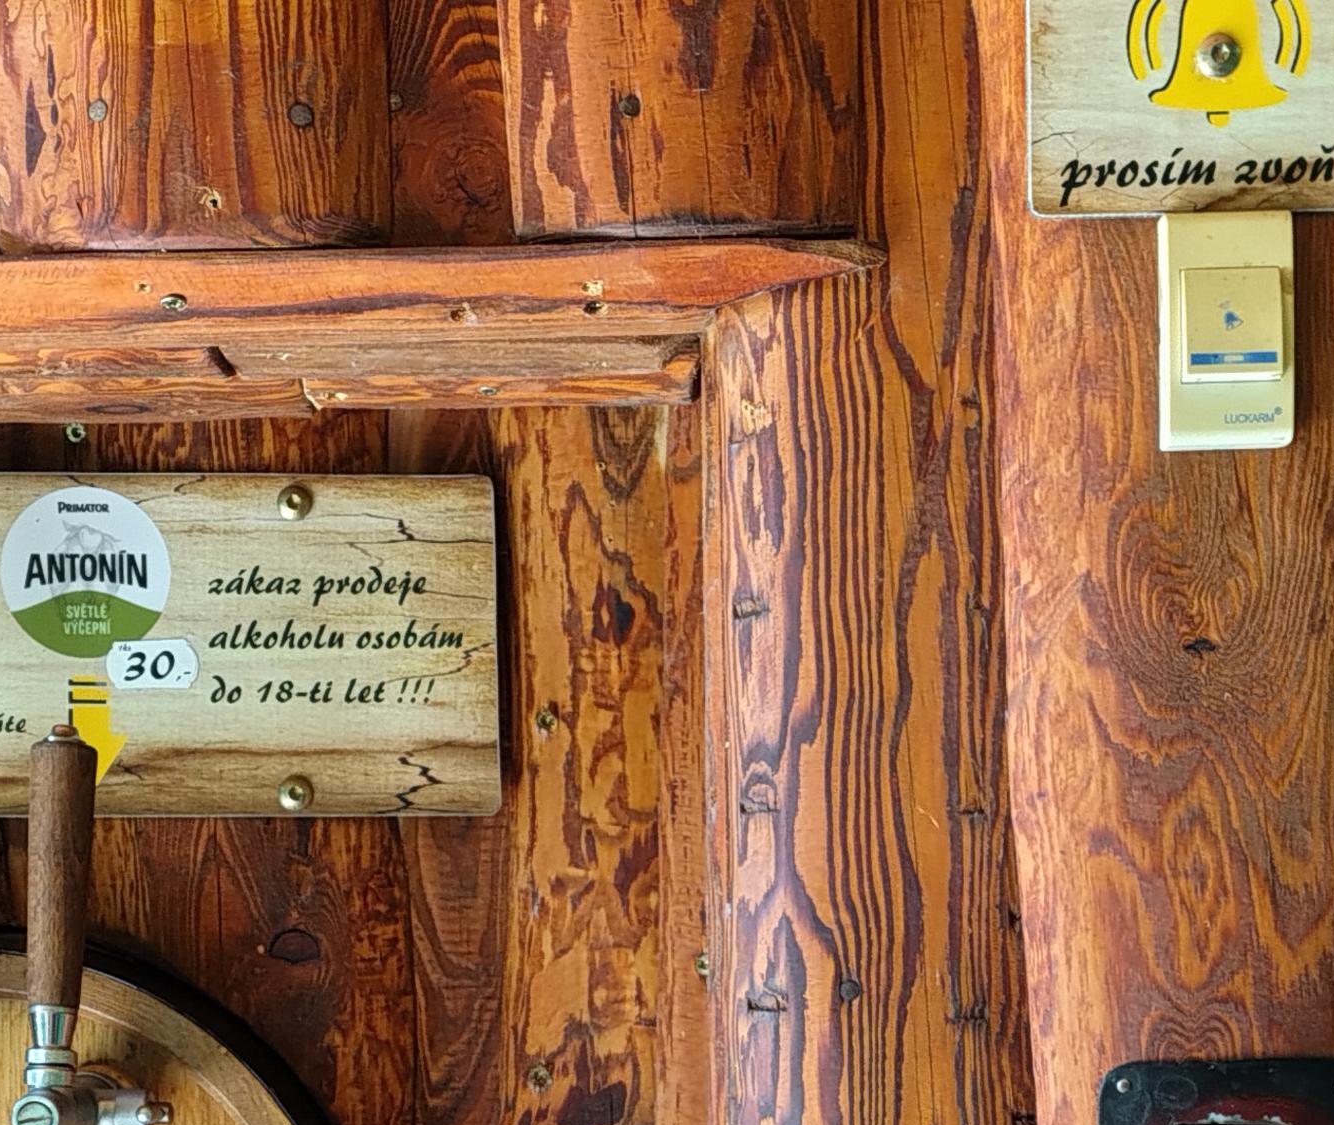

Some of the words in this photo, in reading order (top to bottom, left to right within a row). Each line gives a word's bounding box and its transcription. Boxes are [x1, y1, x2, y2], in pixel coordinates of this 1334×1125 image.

[1059, 147, 1216, 207] prosím
[24, 550, 148, 589] ANTONÍN
[208, 568, 303, 597] zákaz
[312, 566, 428, 606] prodeje
[63, 616, 112, 635] VÝČEPNÍ
[65, 600, 108, 619] SVĚTLÉ
[208, 620, 345, 651] alkoholu
[355, 619, 465, 650] osobám
[210, 676, 241, 704] do
[256, 679, 333, 704] 18-ti
[343, 678, 386, 704] let
[396, 677, 435, 704] !!!
